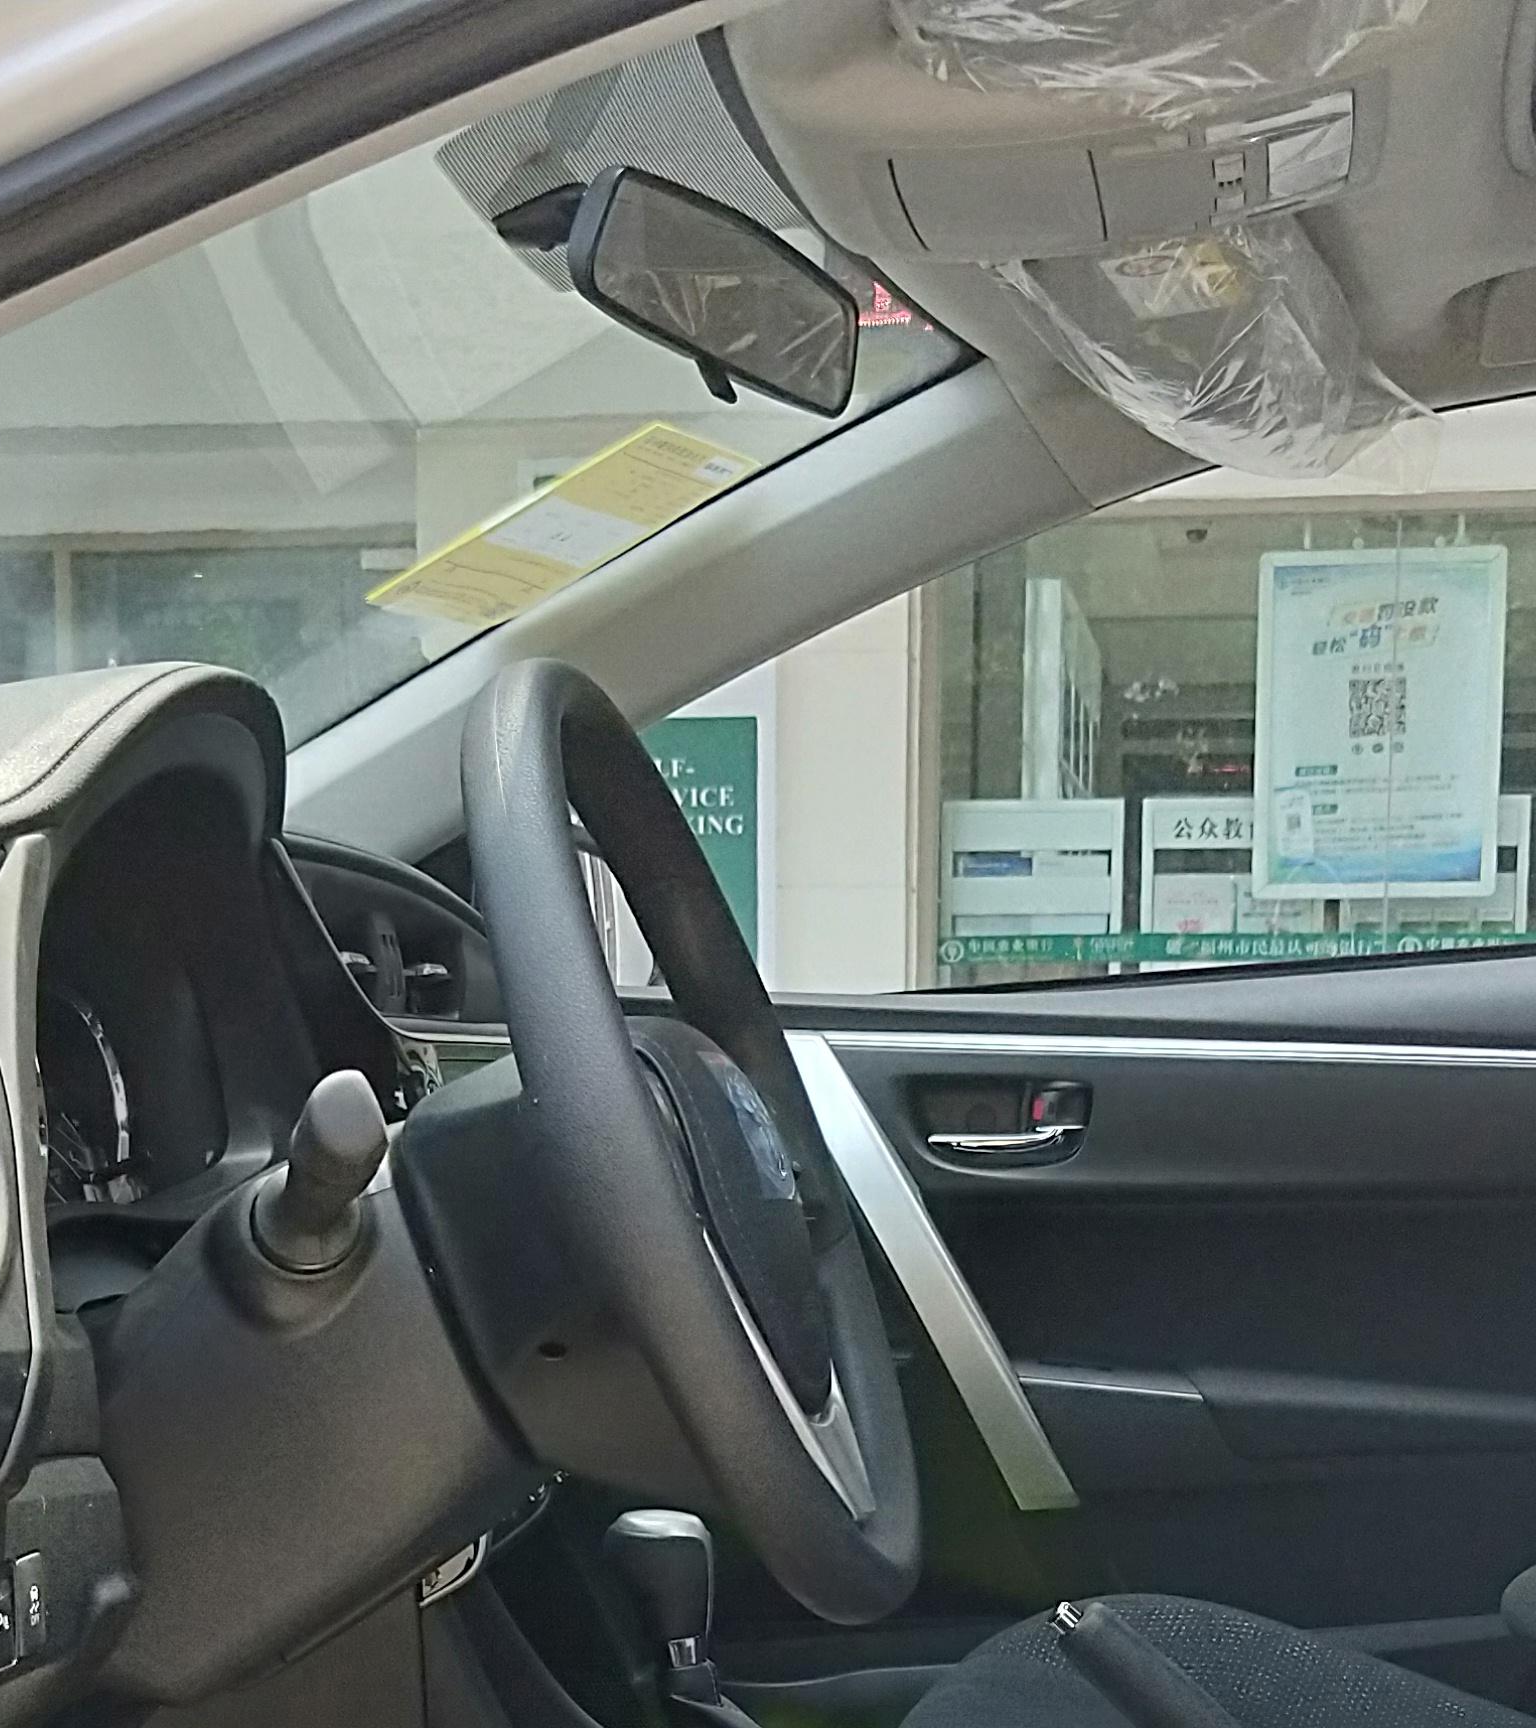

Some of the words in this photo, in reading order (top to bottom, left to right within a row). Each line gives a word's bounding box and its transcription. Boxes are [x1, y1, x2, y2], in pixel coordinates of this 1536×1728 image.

[652, 758, 695, 778] LF-
[670, 785, 734, 808] VICE
[1174, 816, 1253, 840] 公众教
